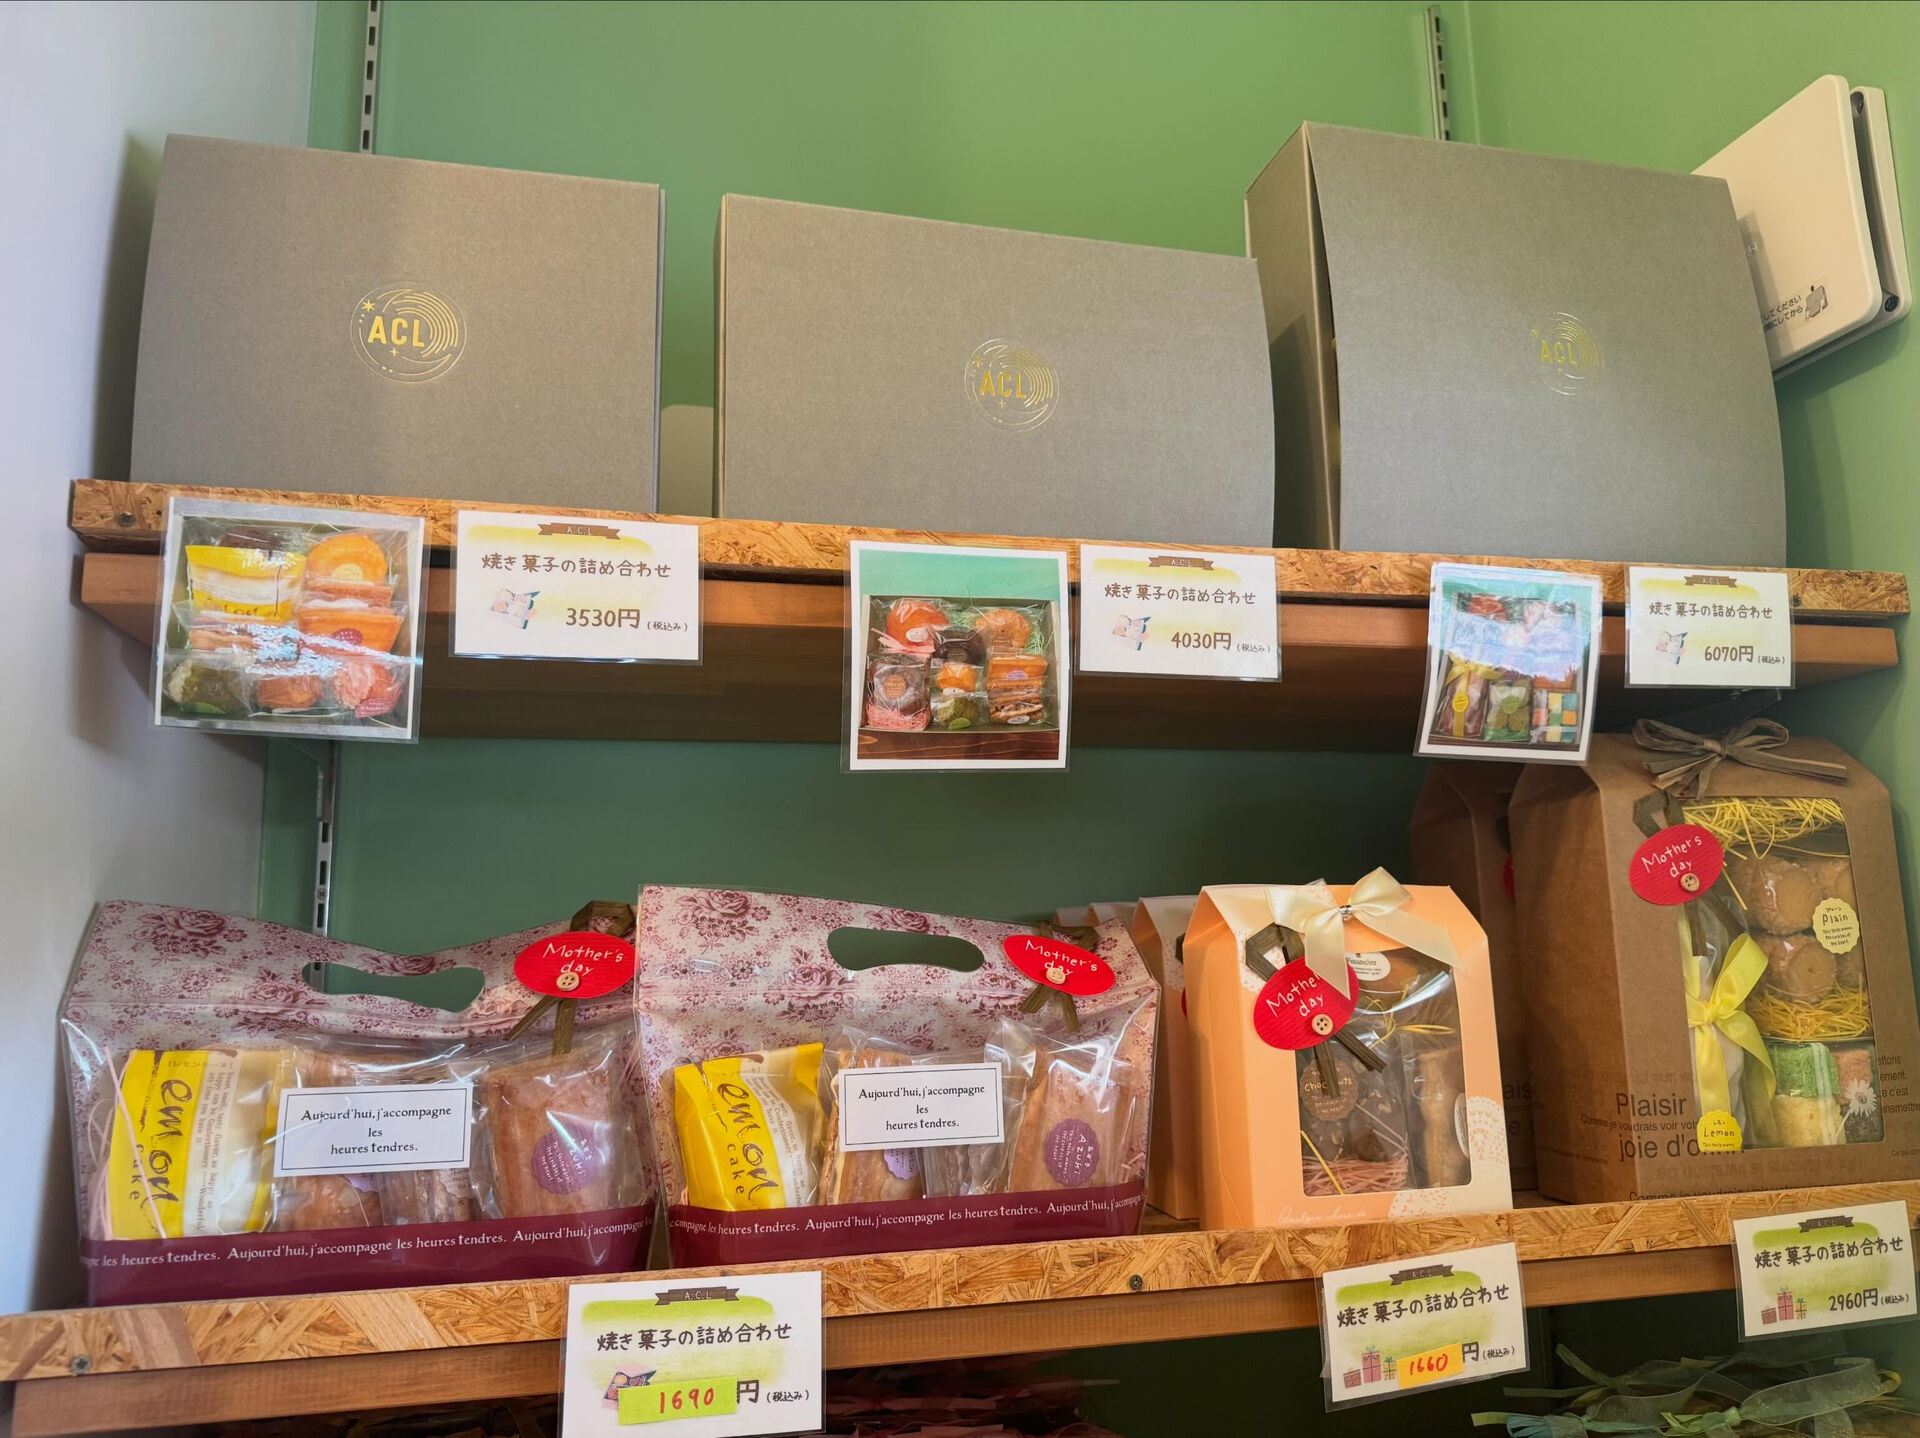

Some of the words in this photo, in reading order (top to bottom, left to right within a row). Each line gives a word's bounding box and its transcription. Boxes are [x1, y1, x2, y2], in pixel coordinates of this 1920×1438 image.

[368, 315, 425, 348] ACL
[980, 370, 1027, 399] ACL
[482, 552, 672, 579] 焼き菓子の詰め合わせ
[1104, 583, 1257, 605] 焼き菓子の詰め合わせ
[565, 607, 641, 629] 3530円
[1649, 602, 1773, 619] 焼き菓子の詰め合わせ
[1171, 632, 1232, 651] 4030円
[1704, 645, 1754, 663] 6070円
[1669, 860, 1692, 878] day
[1822, 914, 1848, 926] Plain
[543, 942, 624, 963] Mother's
[1025, 940, 1098, 972] Mother's
[560, 960, 594, 976] day
[1265, 972, 1320, 1017] Mothe
[1299, 994, 1324, 1017] day
[916, 1104, 929, 1114] les
[1616, 1093, 1686, 1117] Plaisir
[368, 1128, 383, 1137] les
[886, 1120, 918, 1131] heures
[920, 1118, 960, 1129] tendres.
[1618, 1120, 1658, 1132] voudrais
[1660, 1120, 1677, 1131] voir
[1704, 1127, 1735, 1138] Lemon
[330, 1144, 369, 1155] heures
[371, 1141, 418, 1153] tendres.
[1619, 1134, 1658, 1162] joie
[727, 1143, 745, 1195] cake
[718, 1223, 751, 1235] heures
[754, 1221, 800, 1234] tendres.
[948, 1209, 962, 1220] les
[965, 1207, 998, 1219] heures
[1000, 1204, 1042, 1216] tendres.
[102, 1254, 118, 1266] les
[120, 1250, 165, 1267] heures
[167, 1249, 220, 1263] tendres.
[397, 1238, 412, 1249] les
[416, 1236, 456, 1248] heures
[458, 1233, 507, 1245] tendres.
[1754, 1236, 1904, 1269] 焼き菓子の詰め合わせ
[1337, 1284, 1510, 1328] 焼き菓子の詰め合わせ
[1828, 1288, 1879, 1312] 2960円
[597, 1323, 793, 1351] 焼き菓子の詰め合わせ
[1409, 1353, 1449, 1376] 1660
[1462, 1341, 1480, 1363] 円
[659, 1387, 715, 1414] 1690
[736, 1380, 760, 1404] 円
